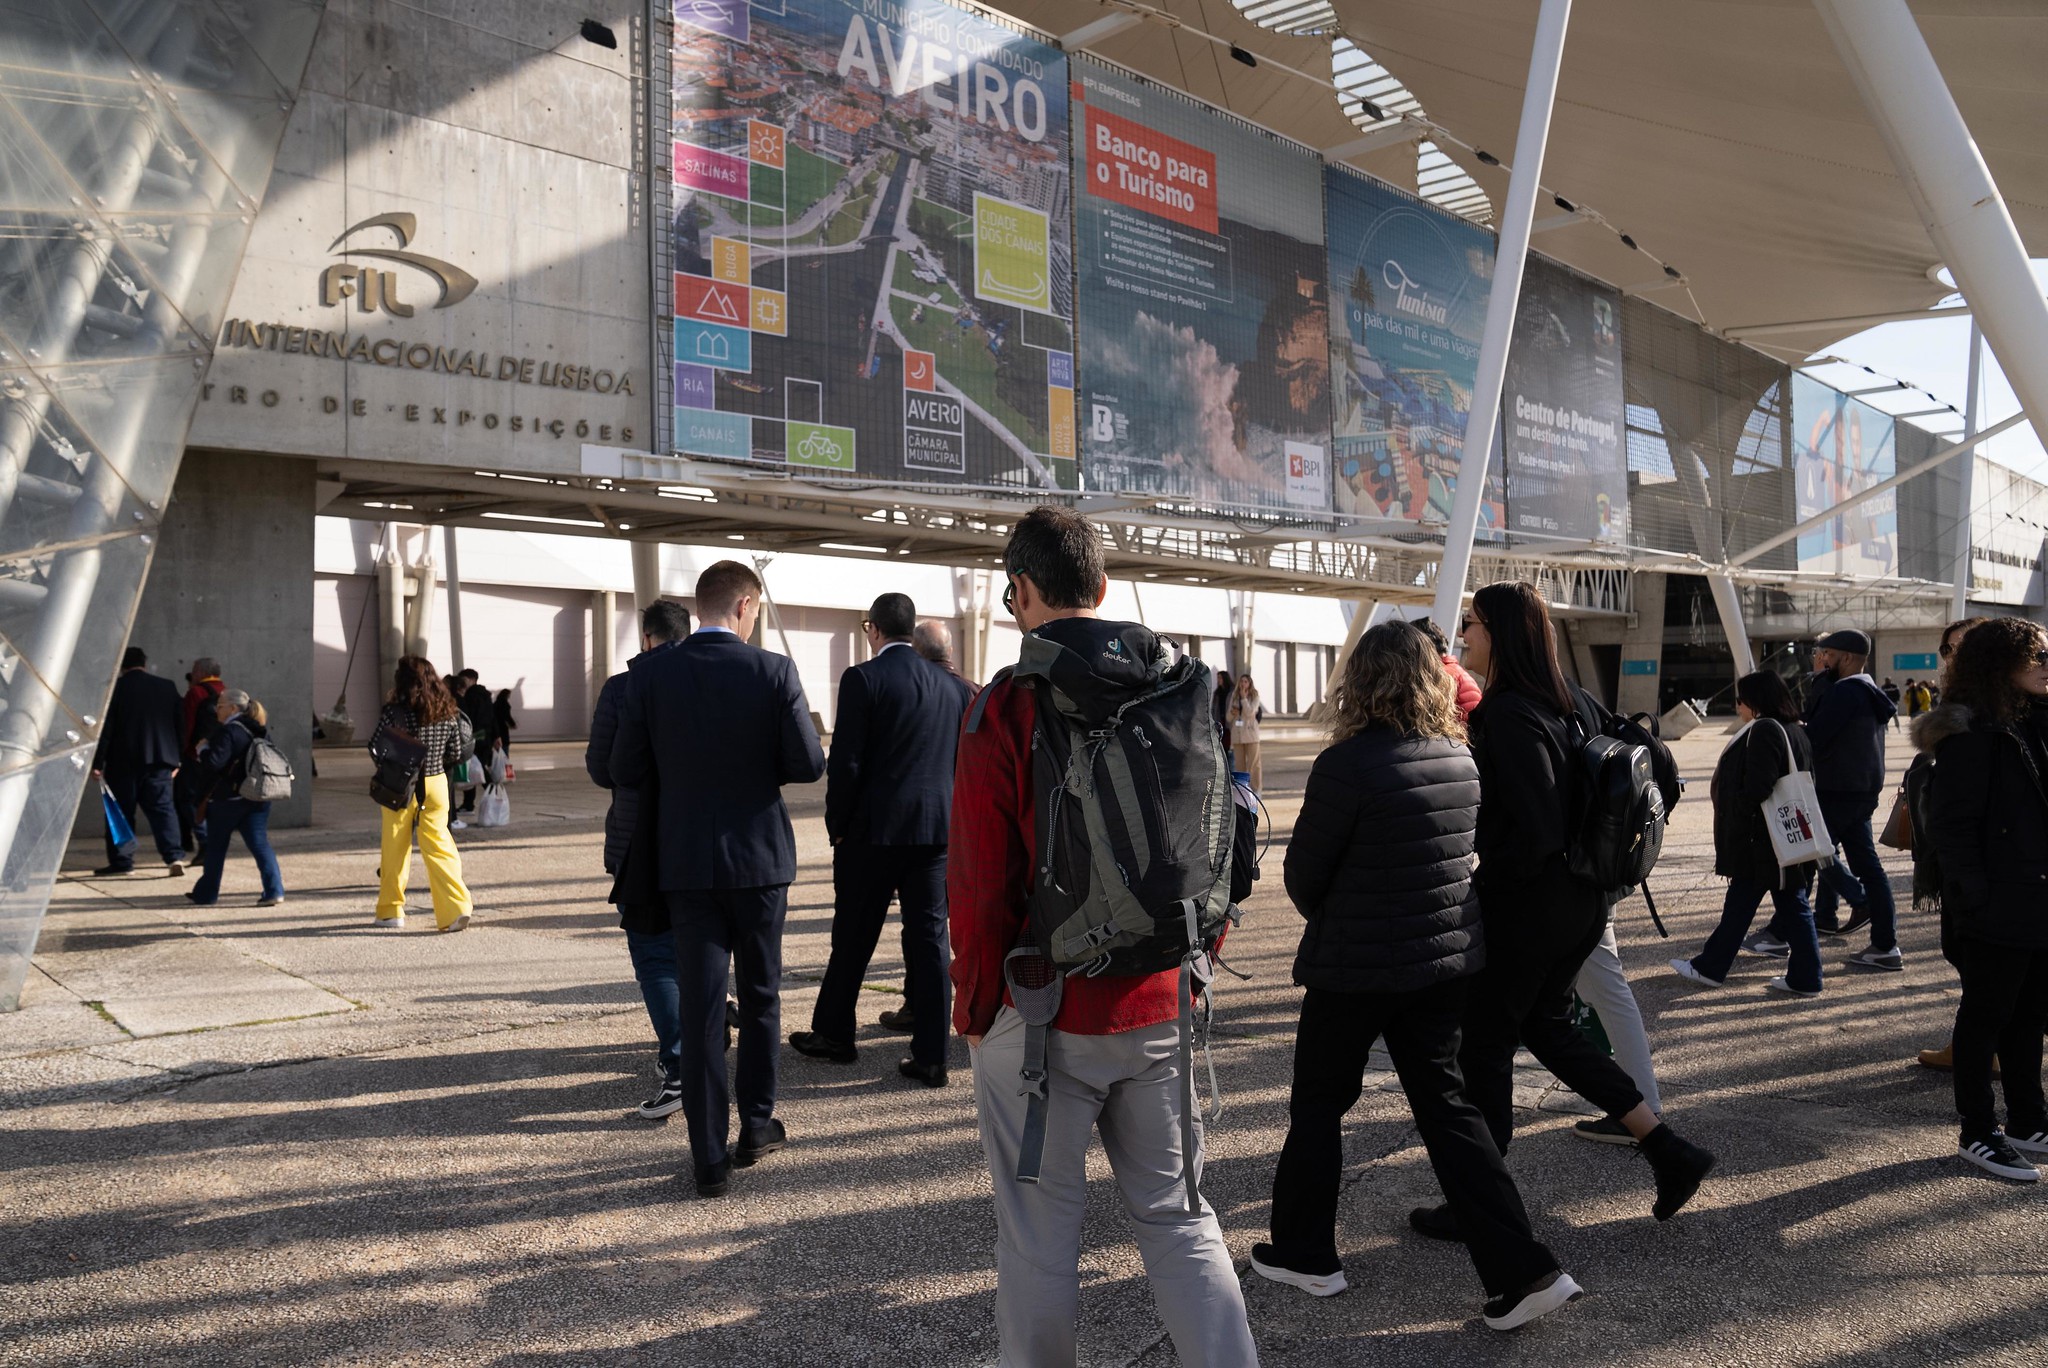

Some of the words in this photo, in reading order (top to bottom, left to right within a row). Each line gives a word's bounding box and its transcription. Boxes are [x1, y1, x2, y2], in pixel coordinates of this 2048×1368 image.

[863, 0, 950, 44] MUNICÍPIO
[956, 30, 1044, 80] CONVIDADO
[837, 14, 1046, 142] AVEIRO
[1099, 82, 1141, 108] EMPRESAS
[1096, 123, 1161, 170] Banco
[1166, 156, 1208, 188] para
[684, 159, 737, 183] SALINAS
[1096, 162, 1110, 184] o
[1115, 161, 1195, 212] Turismo
[980, 208, 1018, 232] CIDADE
[980, 226, 1002, 244] DOS
[1006, 233, 1044, 256] CANAIS
[726, 245, 736, 278] BUGA
[326, 262, 415, 319] FIL
[1105, 276, 1124, 291] Visite
[1130, 284, 1150, 296] nosso
[1382, 260, 1446, 324] Tunisia
[1354, 309, 1362, 322] o
[1386, 316, 1402, 336] das
[1404, 324, 1419, 340] mil
[1421, 330, 1428, 343] e
[1430, 334, 1450, 350] uma
[1451, 338, 1480, 361] viagen
[225, 318, 492, 378] INTERNACIONAL
[499, 355, 536, 384] DE
[540, 360, 636, 396] LISBOA
[683, 378, 705, 394] RIA
[322, 395, 368, 417] DE
[406, 404, 634, 443] EXPOSIÇÕES
[907, 398, 961, 425] AVEIRO
[1516, 394, 1555, 426] Centro
[1556, 406, 1570, 430] de
[1571, 410, 1618, 448] Portugal,
[690, 425, 736, 444] CANAIS
[1063, 415, 1071, 454] MOLES
[1516, 424, 1530, 440] um
[1531, 425, 1560, 446] destino
[1562, 435, 1567, 448] e
[908, 448, 961, 466] MUNICIPAL
[1303, 460, 1320, 478] BPI
[1102, 650, 1132, 664] deuter
[1786, 830, 1803, 844] CIT
